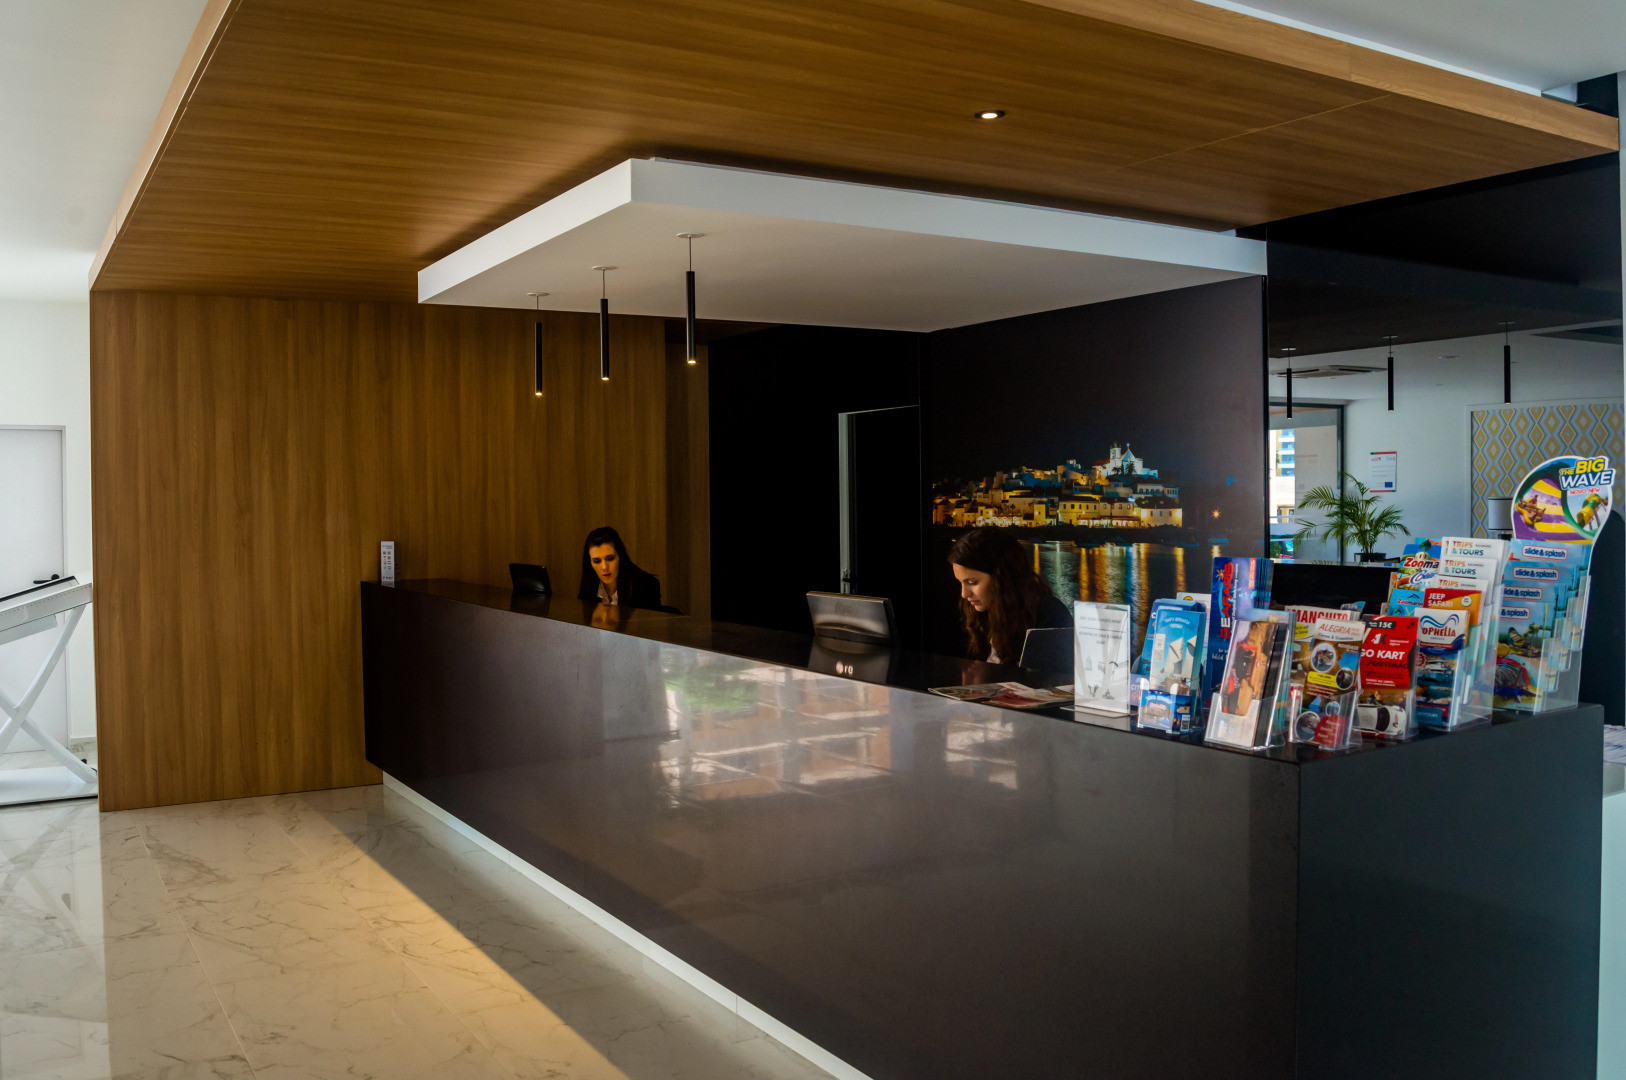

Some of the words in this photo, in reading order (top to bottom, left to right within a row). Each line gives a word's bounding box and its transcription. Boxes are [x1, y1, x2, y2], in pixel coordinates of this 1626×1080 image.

[1576, 458, 1605, 474] BIG
[1561, 470, 1612, 488] WAVE
[1524, 547, 1539, 555] slide
[1544, 549, 1566, 558] splash
[1403, 558, 1439, 569] Zooma
[1536, 570, 1557, 579] splash
[1439, 579, 1459, 587] TRIPS
[1520, 589, 1540, 597] splash
[1220, 562, 1234, 639] SEAFARIS
[1506, 609, 1528, 617] splash
[1319, 623, 1351, 635] ALEGRIA
[1361, 649, 1374, 658] GO
[1377, 650, 1405, 660] KART
